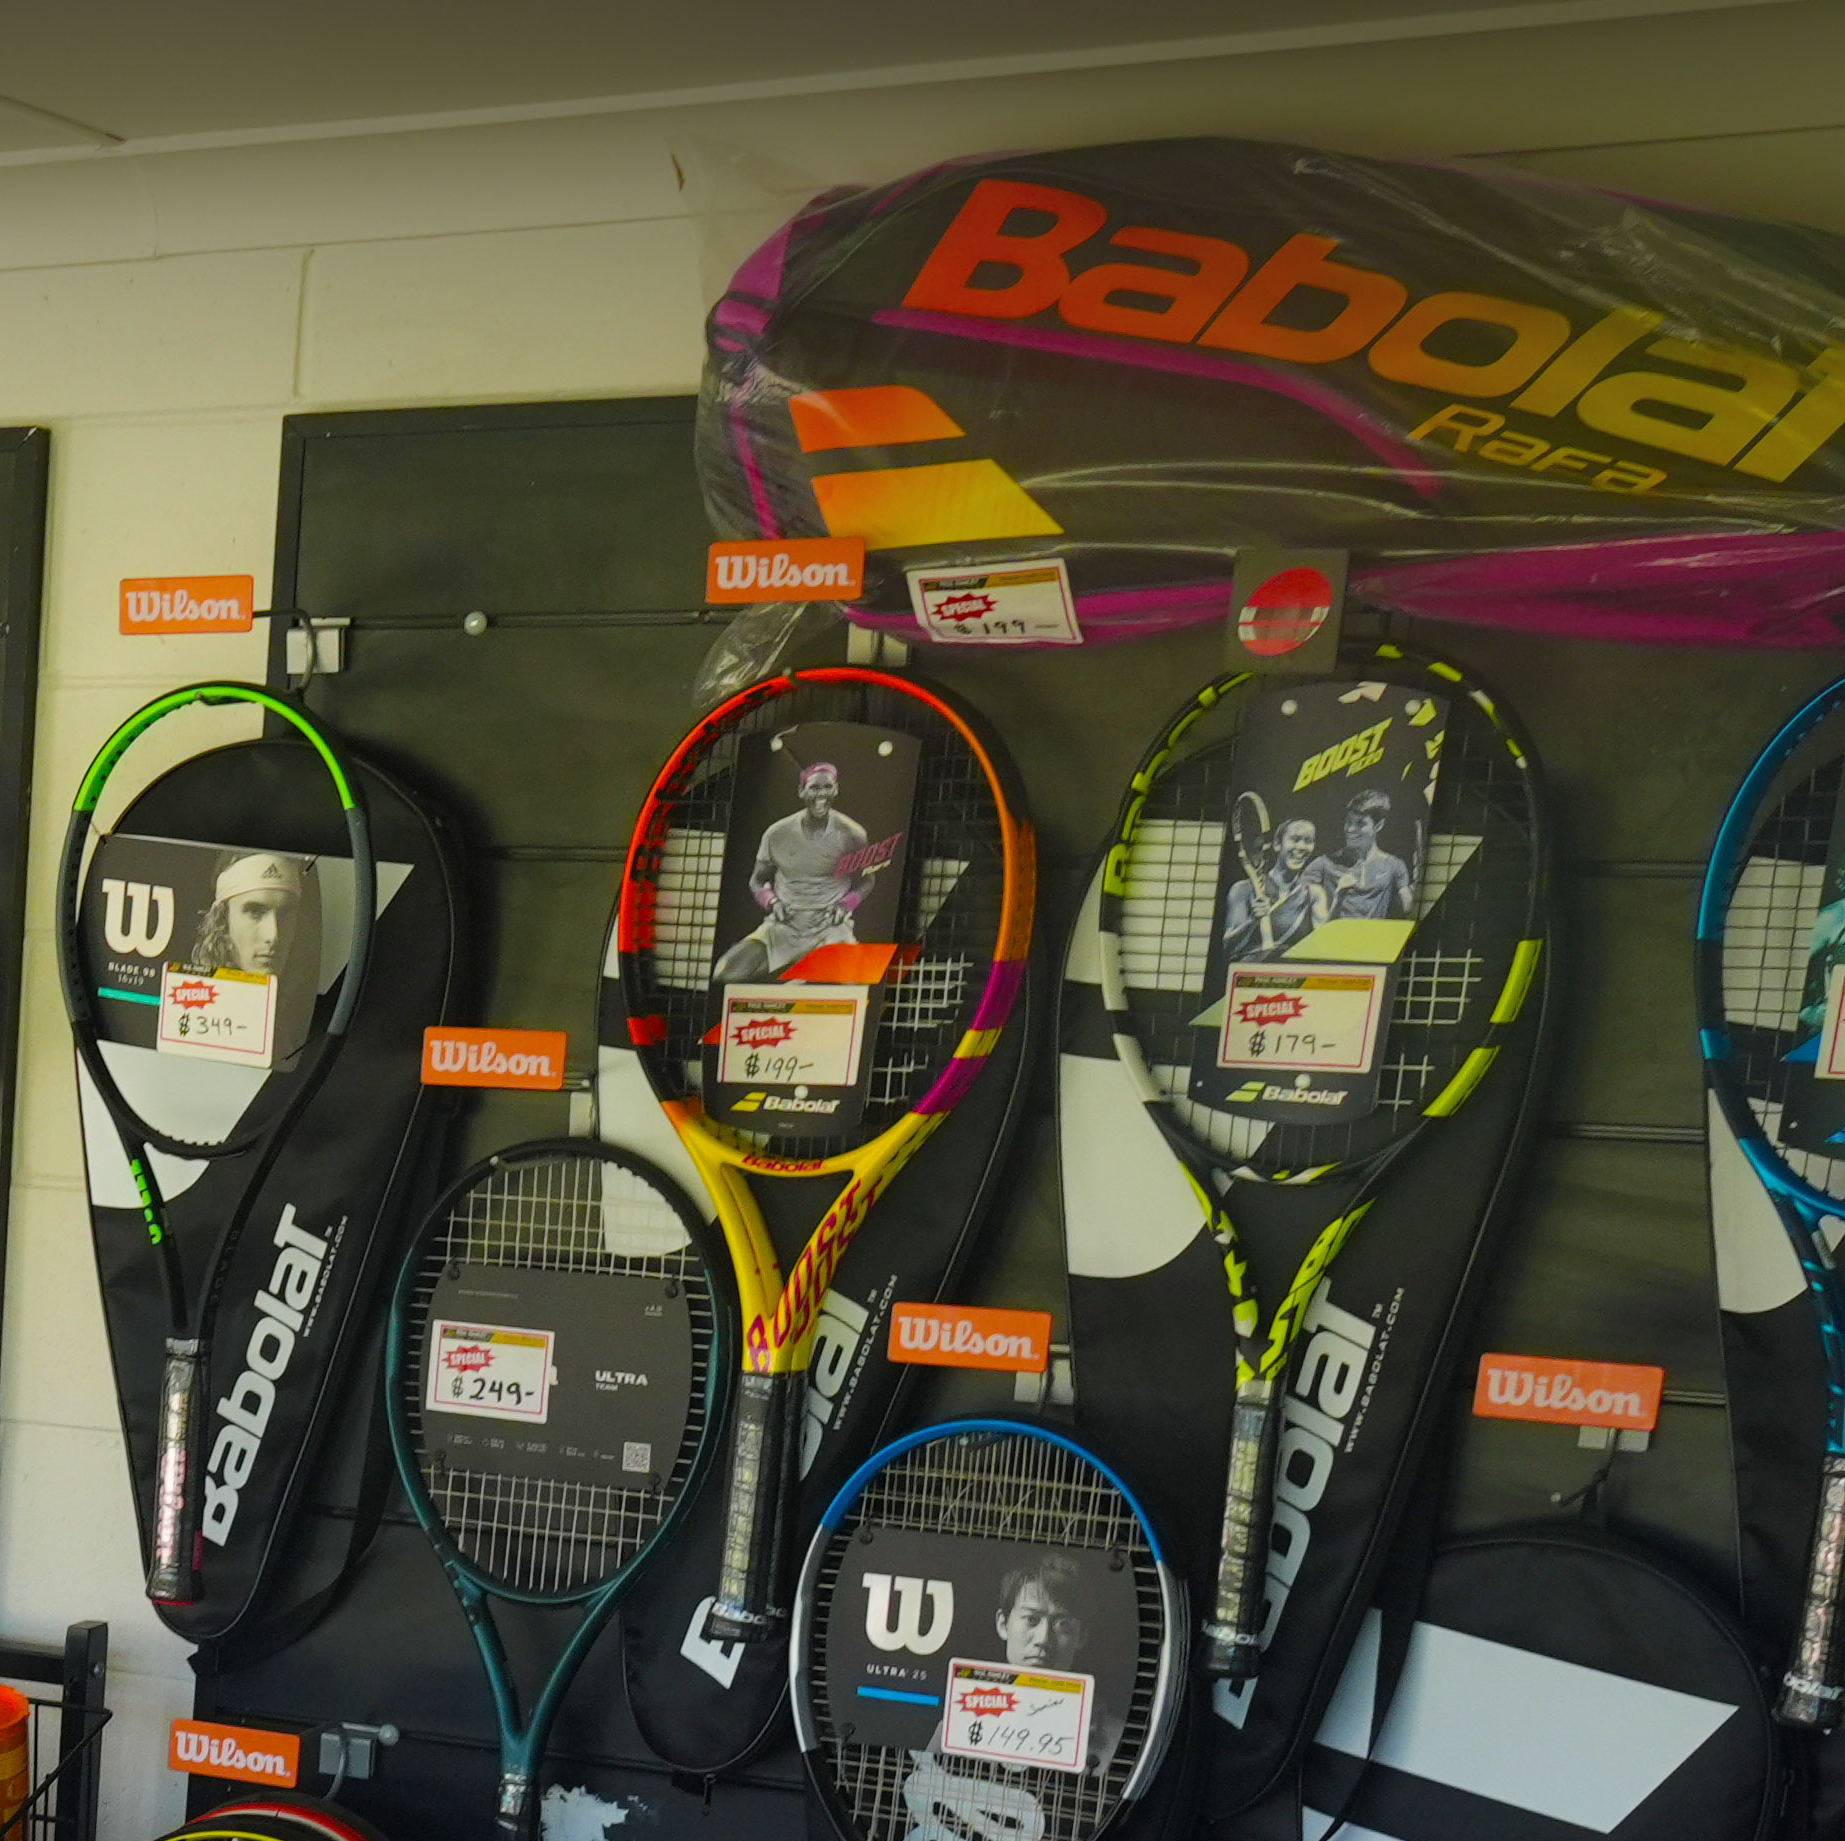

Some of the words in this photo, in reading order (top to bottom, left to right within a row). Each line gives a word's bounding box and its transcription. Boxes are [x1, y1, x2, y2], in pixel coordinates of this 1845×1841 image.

[714, 546, 850, 589] Wilson
[125, 589, 242, 624] Wilson
[937, 596, 989, 620] SPECIAL
[1291, 717, 1394, 793] BOOST
[108, 961, 139, 976] BLADE
[142, 966, 157, 979] 98
[174, 986, 212, 1003] SPECIAL
[1244, 999, 1296, 1021] SPECIAL
[739, 1022, 787, 1043] SPECIAL
[428, 1039, 552, 1080] Wilson
[762, 1092, 842, 1116] Babolat
[1262, 1085, 1348, 1106] Babolat
[897, 1315, 1035, 1361] Wilson
[450, 1350, 489, 1367] SPECIAL
[203, 1202, 332, 1546] Babolat
[595, 1369, 648, 1386] ULTRA
[595, 1383, 619, 1391] TEAM
[1485, 1368, 1642, 1417] Wilson
[866, 1663, 906, 1681] ULTRA
[965, 1695, 1008, 1708] SPECIAL
[968, 1719, 1074, 1755] $149.95
[175, 1728, 287, 1777] Wilson
